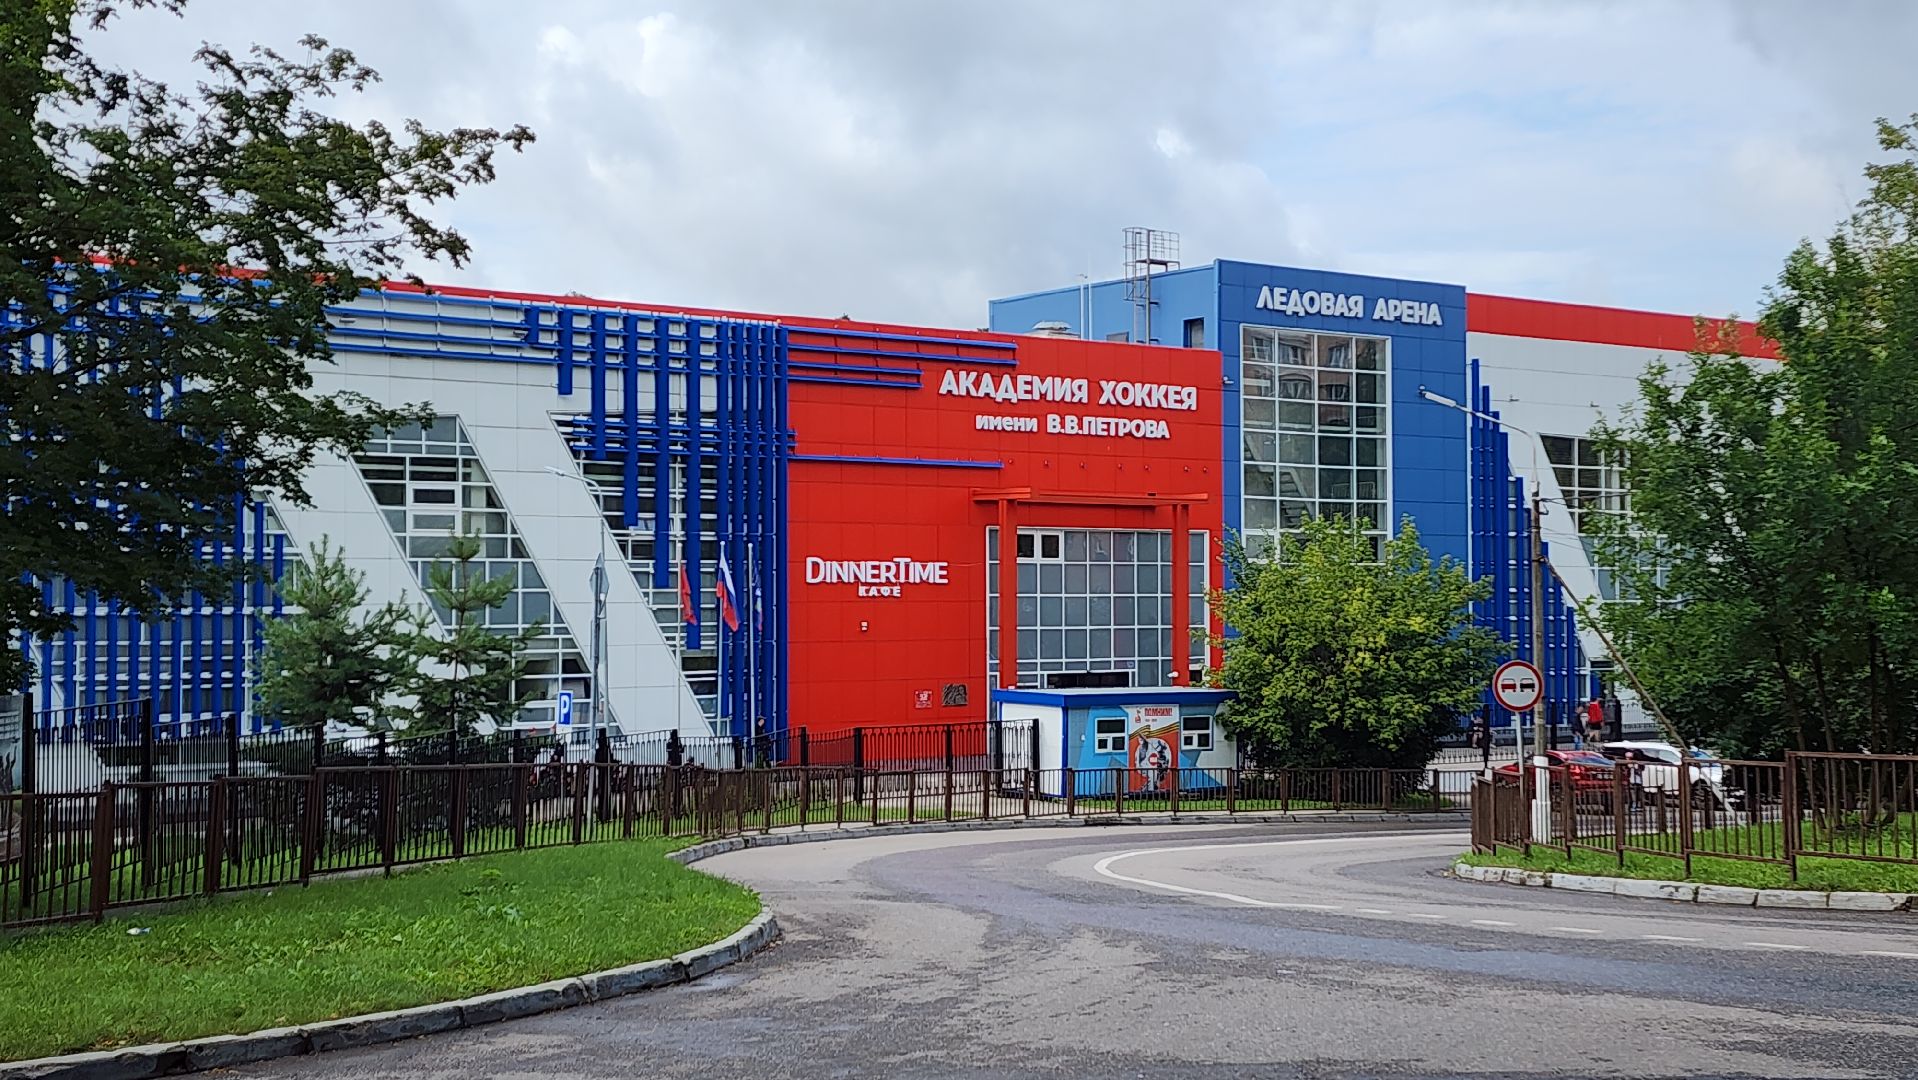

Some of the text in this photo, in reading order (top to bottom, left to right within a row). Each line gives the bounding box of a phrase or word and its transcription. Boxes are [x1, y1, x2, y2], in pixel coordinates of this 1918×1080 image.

[1256, 286, 1443, 325] ЛЕДОВАЯ АРЕНА
[939, 369, 1197, 411] АКАДЕМИЯ ХОККЕЯ
[975, 413, 1171, 439] имени В.В.ПЕТРОВА
[858, 585, 901, 597] КАФЕ
[560, 694, 570, 723] P
